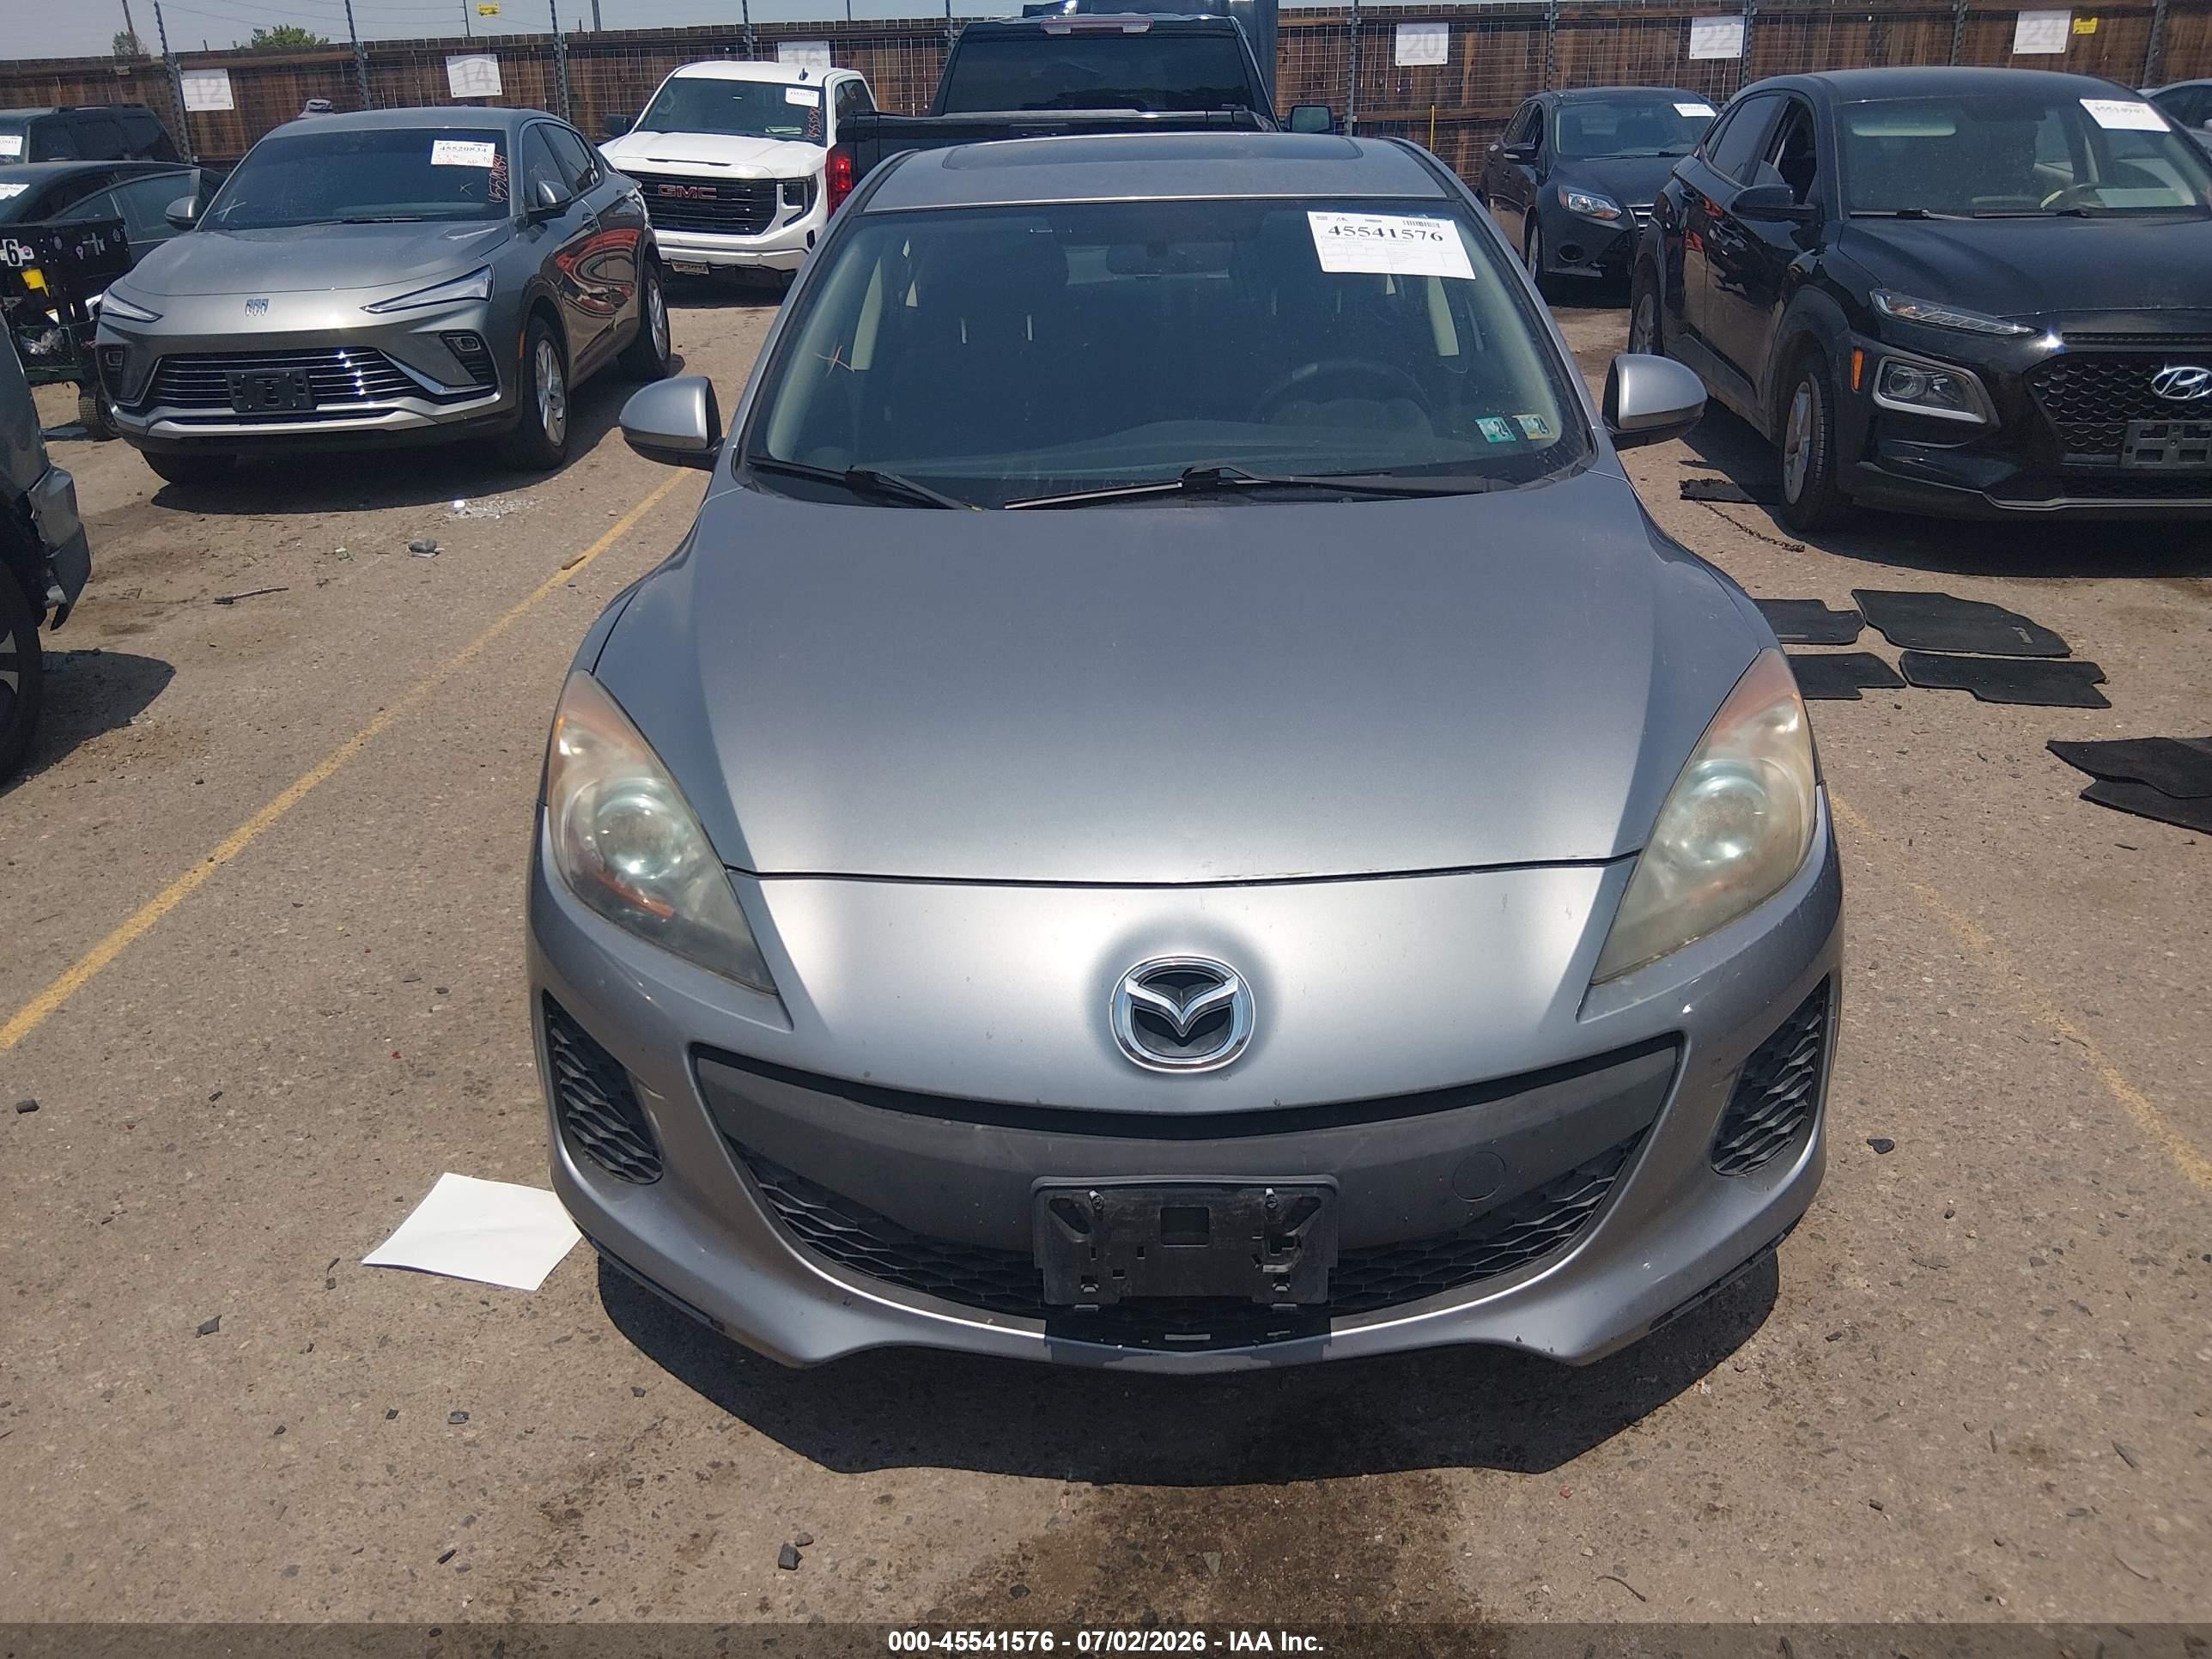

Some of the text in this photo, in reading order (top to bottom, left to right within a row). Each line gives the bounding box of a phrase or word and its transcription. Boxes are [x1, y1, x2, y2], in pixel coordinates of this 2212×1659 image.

[1403, 29, 1440, 58] 20
[456, 61, 494, 89] 14
[191, 76, 229, 103] 12
[658, 184, 717, 199] GMC
[1328, 225, 1443, 241] 45541576
